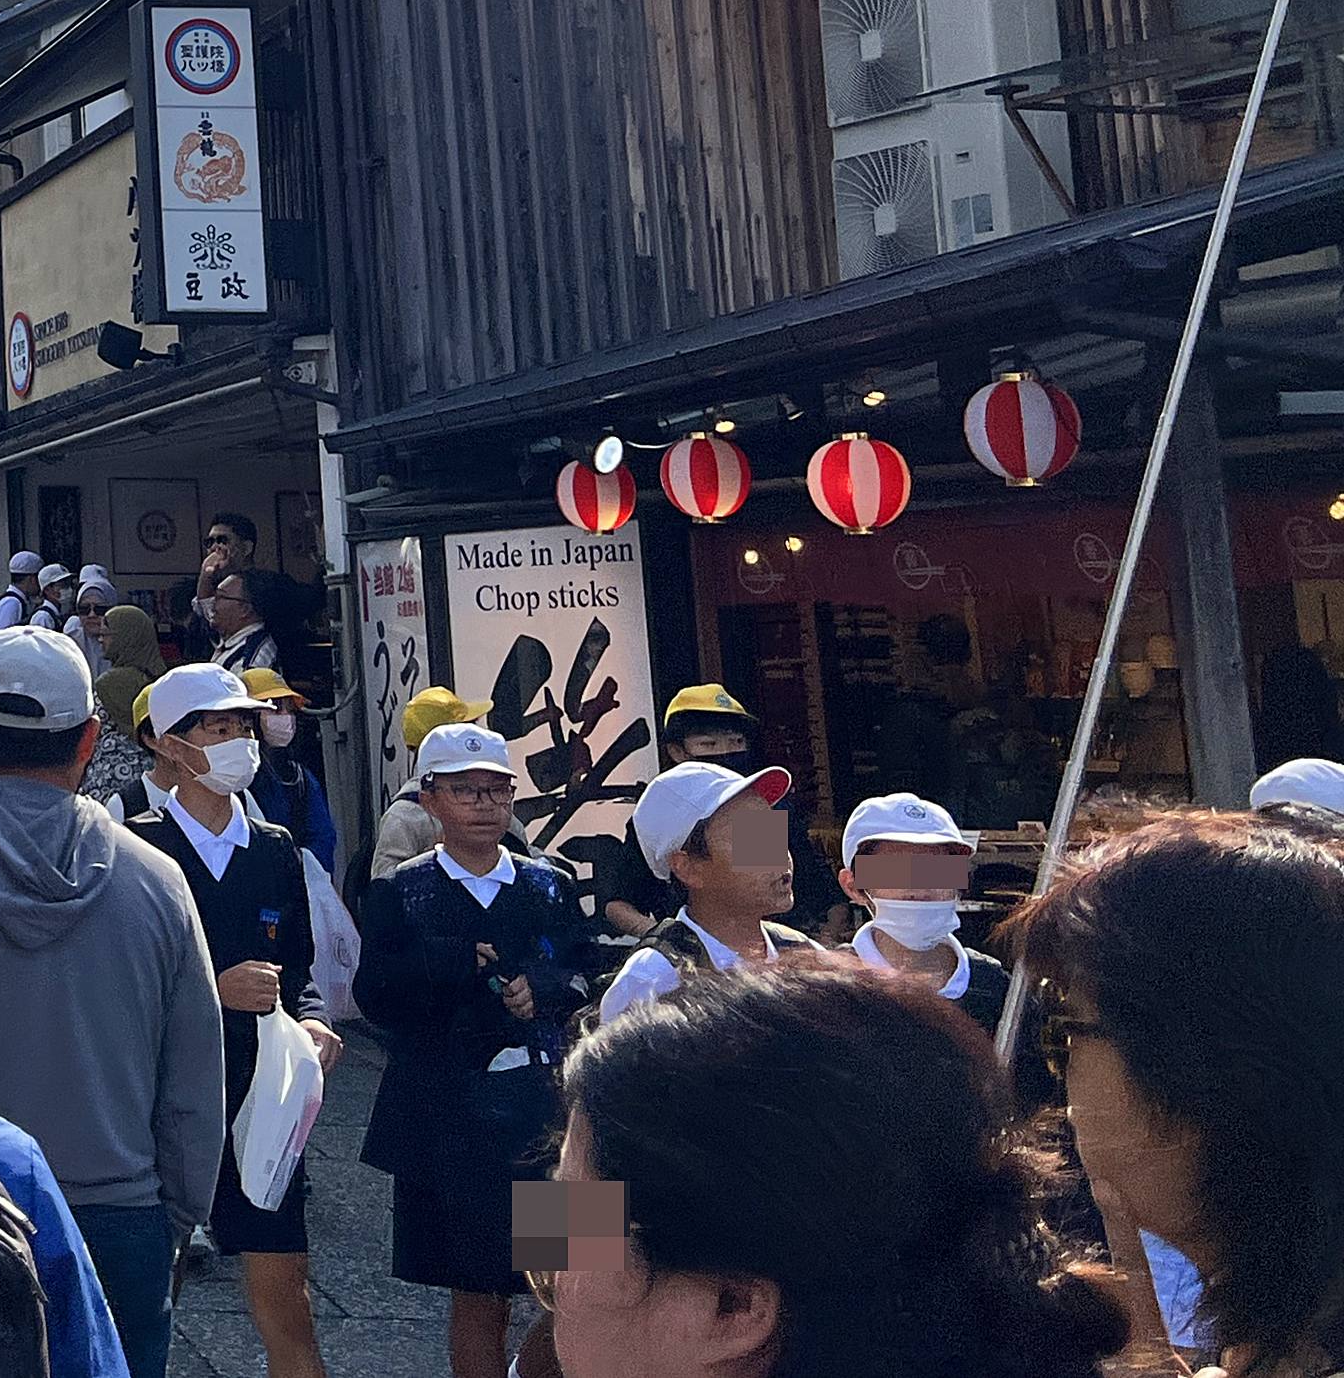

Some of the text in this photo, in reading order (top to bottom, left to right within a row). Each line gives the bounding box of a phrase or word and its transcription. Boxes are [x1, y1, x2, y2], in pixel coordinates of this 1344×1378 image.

[457, 539, 634, 571] Made in Japan
[476, 580, 620, 617] Chop sticks
